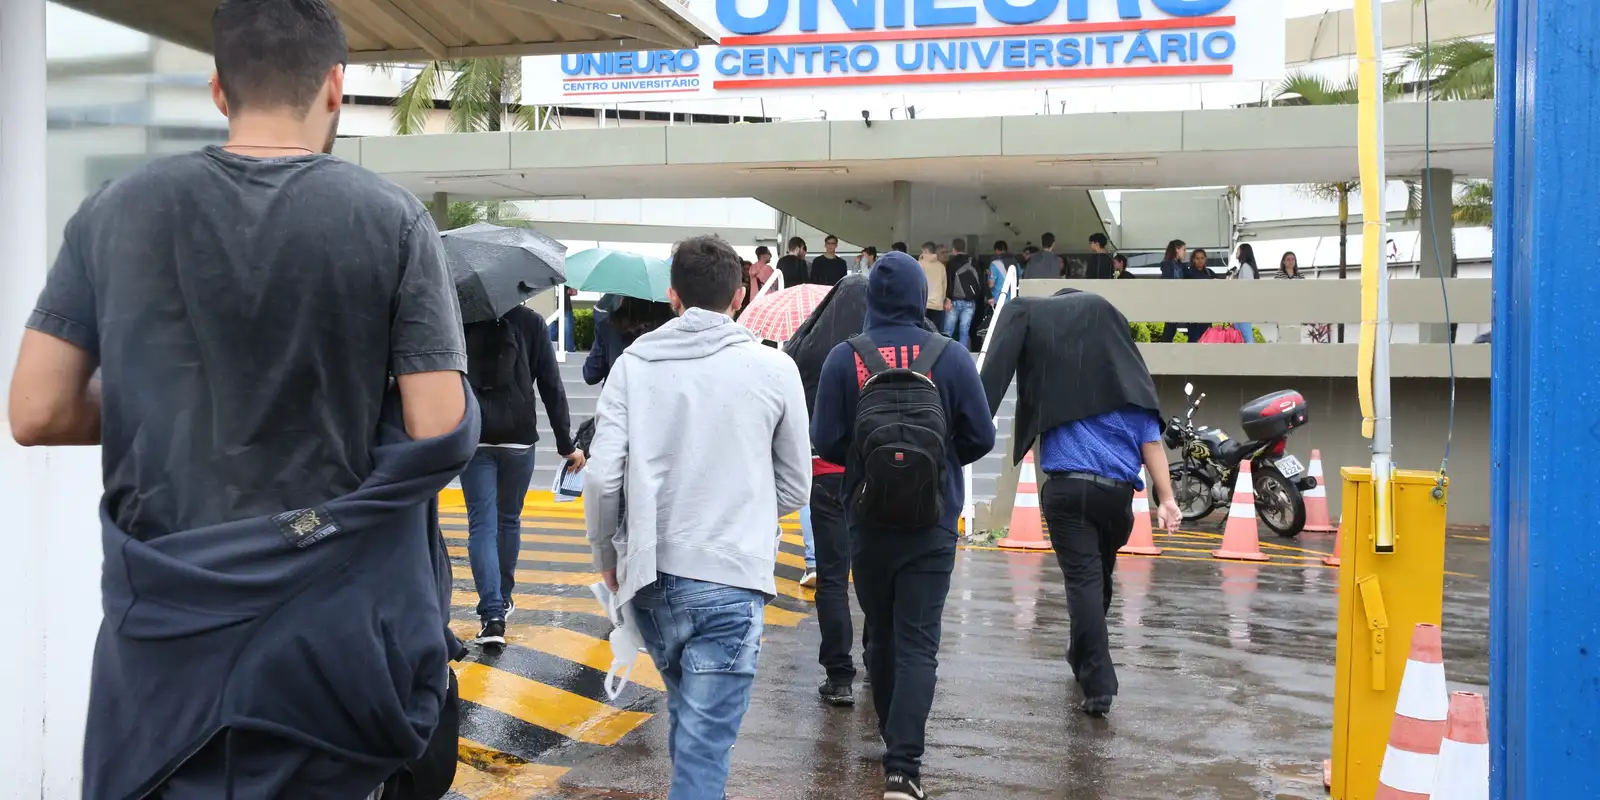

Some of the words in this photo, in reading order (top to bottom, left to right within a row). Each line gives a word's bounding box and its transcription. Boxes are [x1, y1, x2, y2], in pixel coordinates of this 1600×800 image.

[560, 49, 700, 75] UNIEURO
[714, 44, 880, 76] CENTRO
[895, 29, 1236, 71] UNIVERSITÁRIO
[562, 82, 608, 91] CENTRO
[612, 76, 700, 90] UNIVERSITÁRIO
